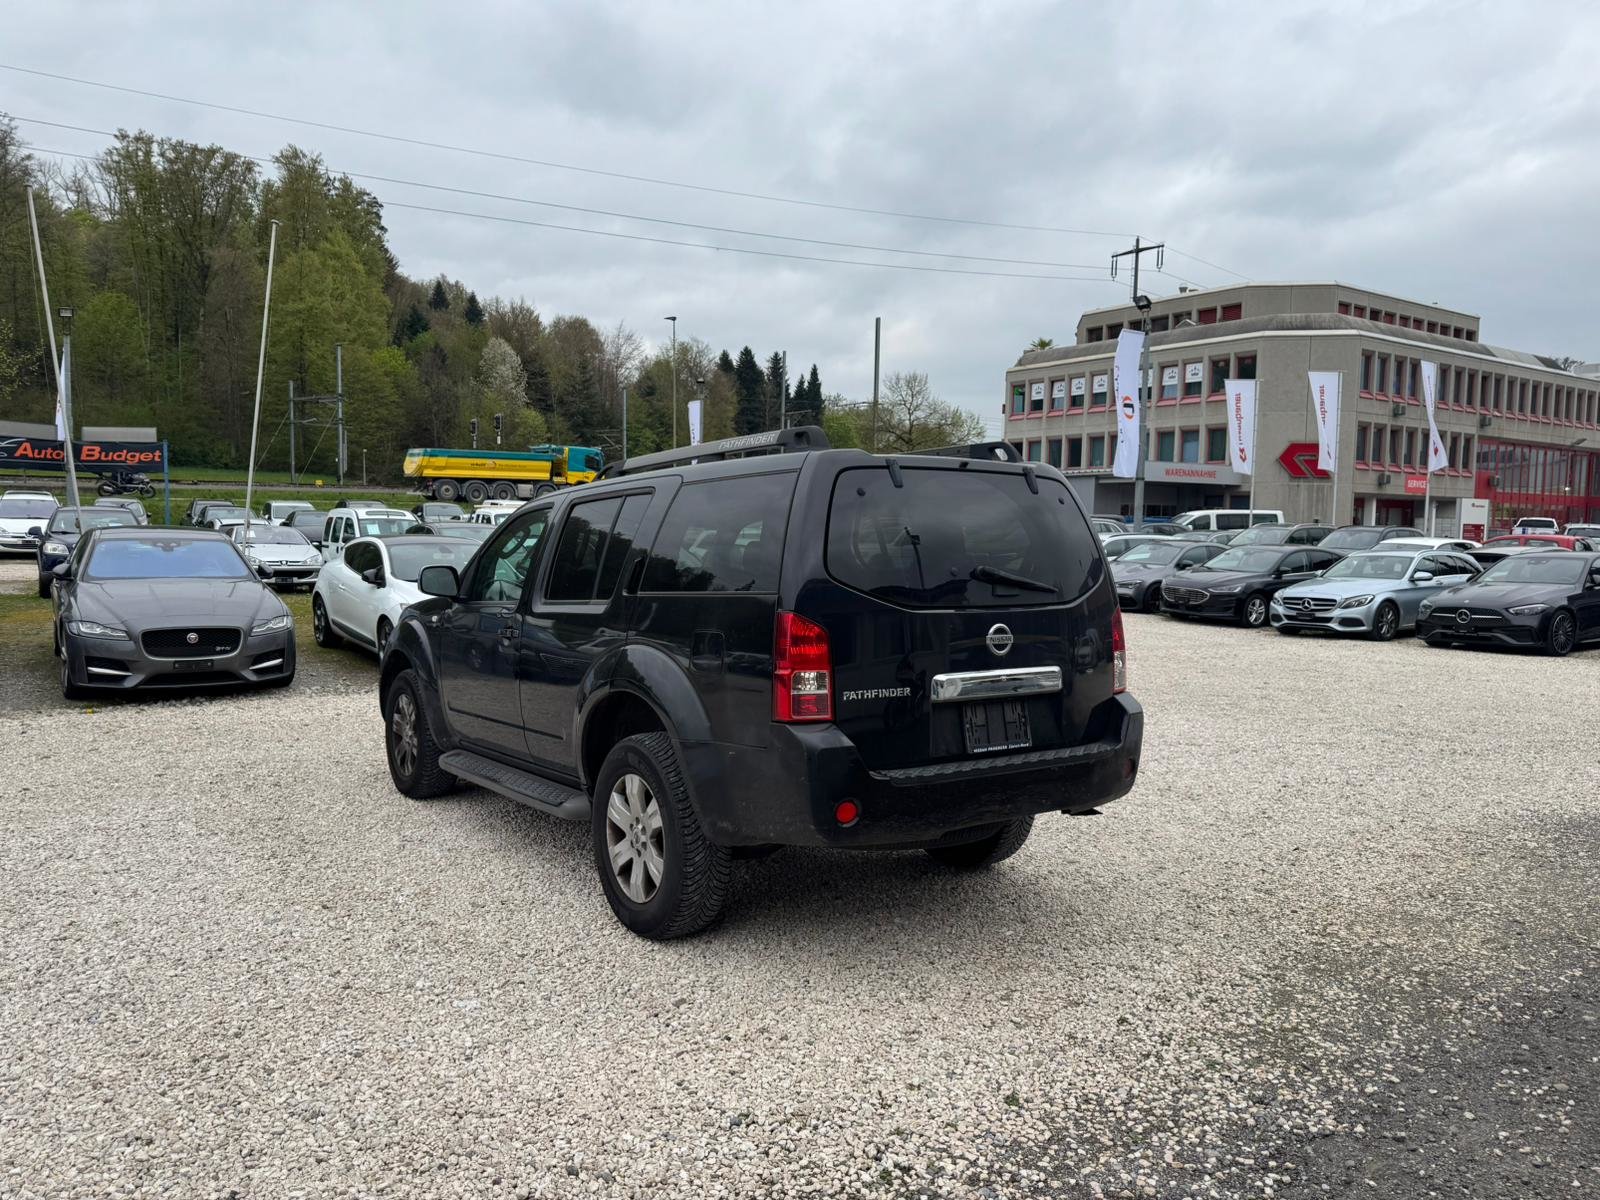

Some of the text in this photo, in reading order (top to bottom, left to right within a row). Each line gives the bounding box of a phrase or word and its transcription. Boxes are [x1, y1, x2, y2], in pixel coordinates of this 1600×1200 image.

[719, 433, 776, 450] PATHFINDER
[14, 442, 162, 464] Auto Budget
[1164, 468, 1217, 479] WARENANNAHME
[1407, 479, 1427, 489] SERVICE
[989, 635, 1012, 644] NISSAN
[843, 687, 911, 700] PATHFINDER
